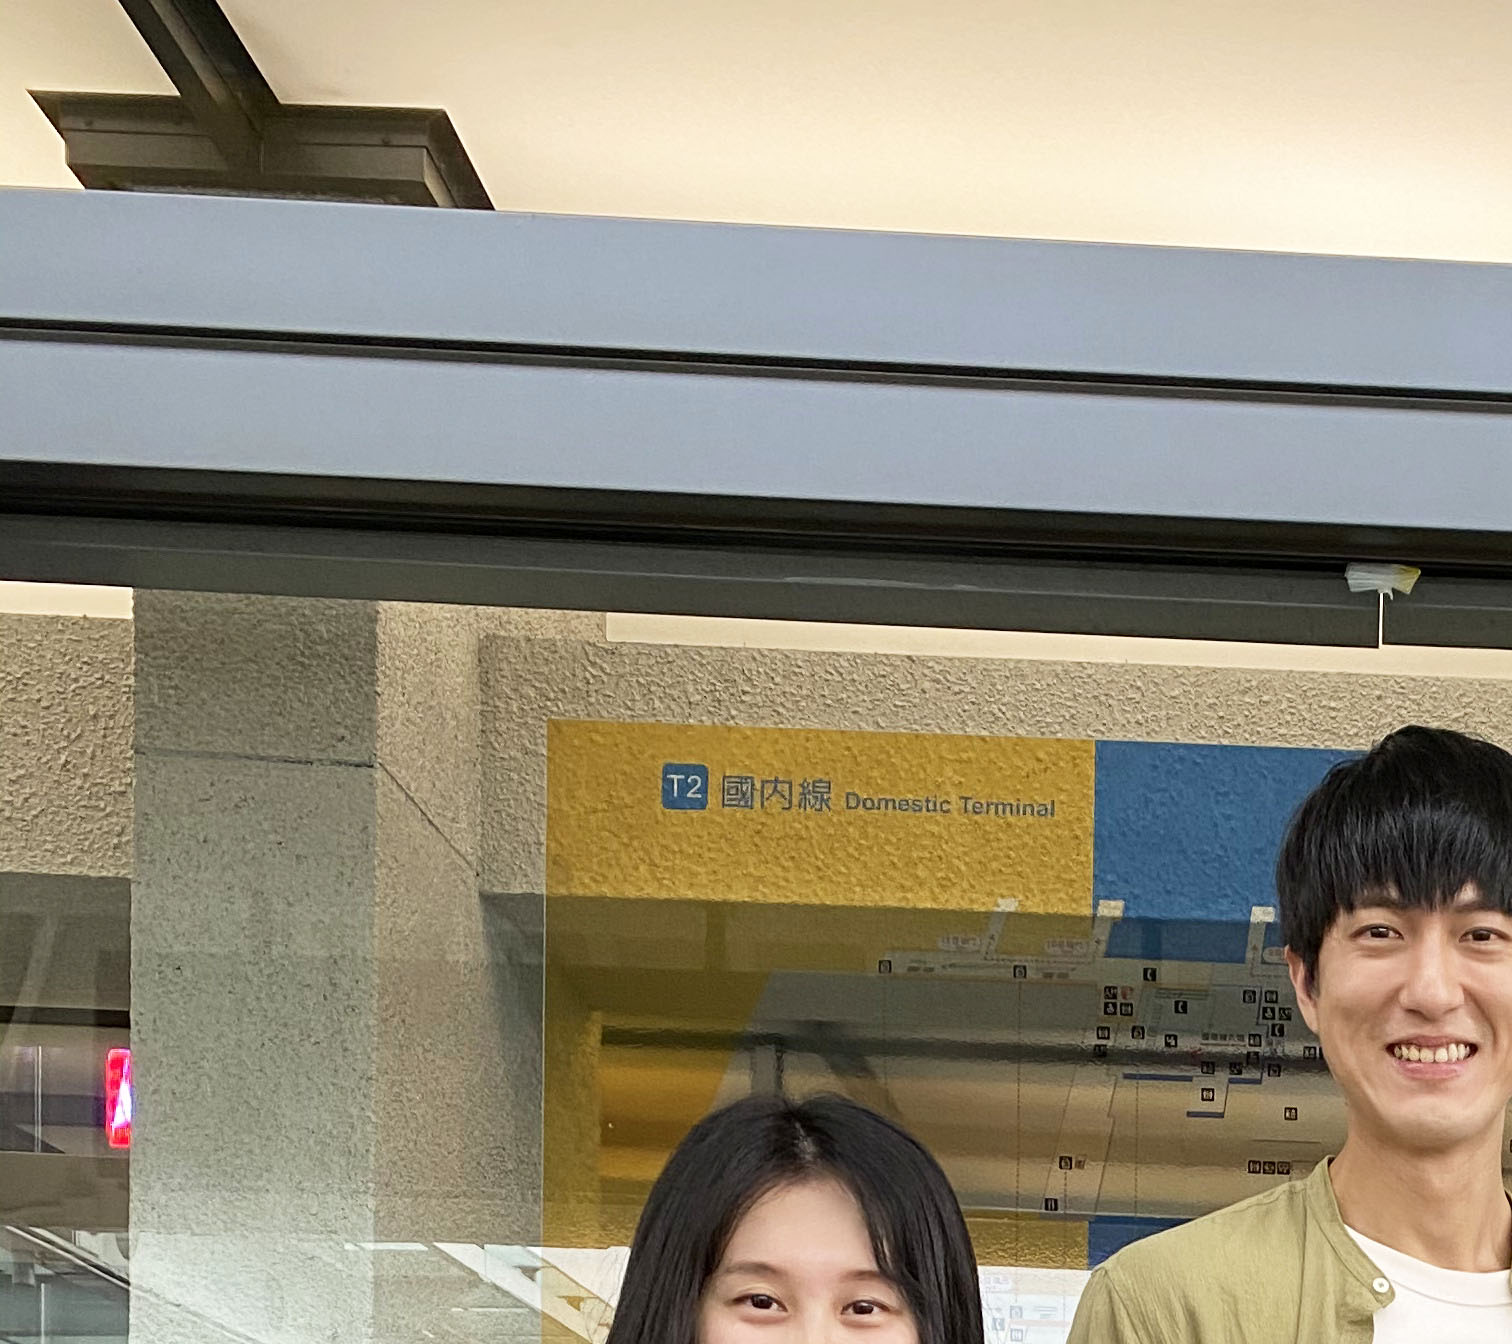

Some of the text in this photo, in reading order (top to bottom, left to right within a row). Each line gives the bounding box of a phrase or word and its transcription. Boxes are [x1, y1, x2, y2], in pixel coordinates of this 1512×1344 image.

[666, 774, 1056, 818] T2 國內線 Domestic Terminal
